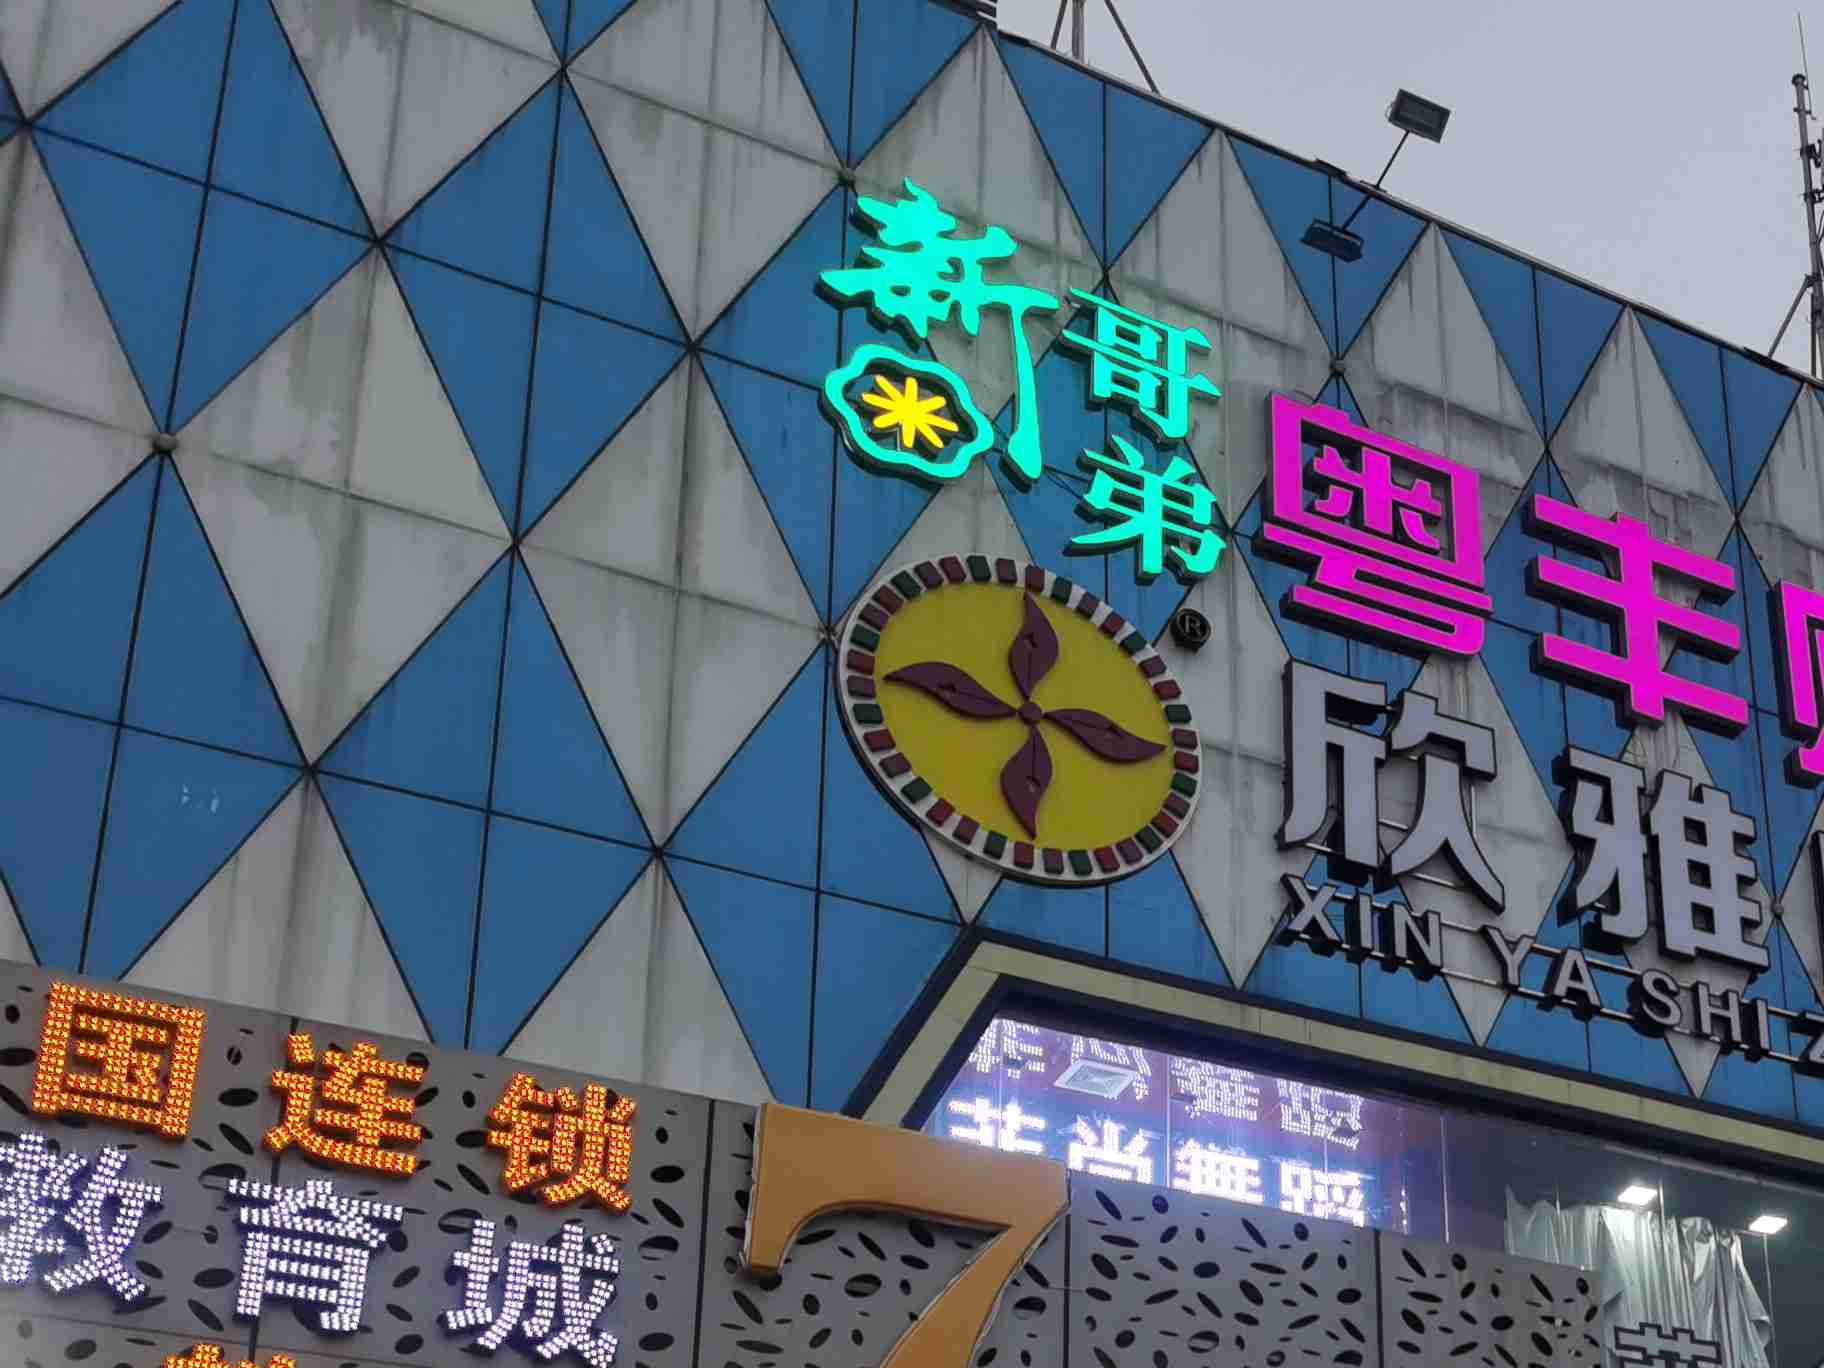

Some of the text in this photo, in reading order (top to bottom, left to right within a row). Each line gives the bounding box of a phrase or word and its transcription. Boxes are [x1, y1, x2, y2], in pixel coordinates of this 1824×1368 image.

[1281, 872, 1443, 976] XIN
[1483, 923, 1601, 1011] YA
[1628, 967, 1773, 1060] SHI
[31, 978, 637, 1212] 国连锁
